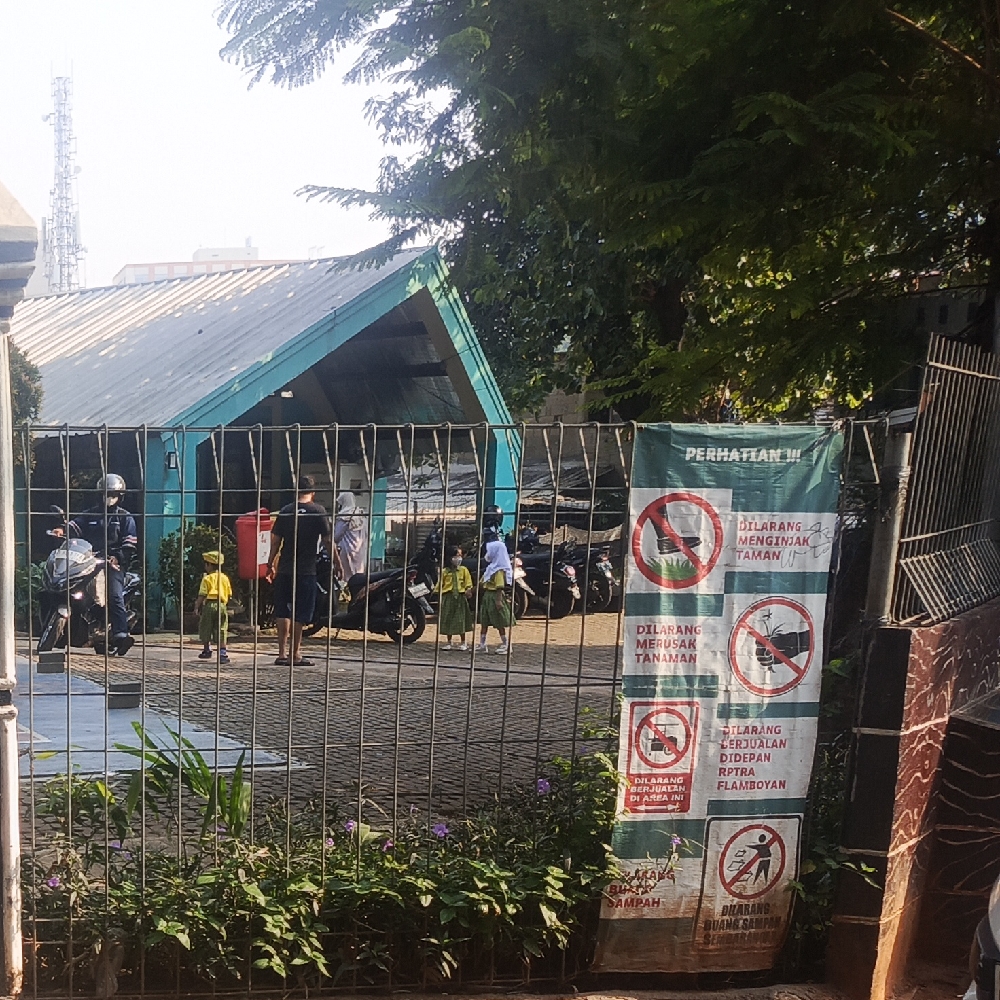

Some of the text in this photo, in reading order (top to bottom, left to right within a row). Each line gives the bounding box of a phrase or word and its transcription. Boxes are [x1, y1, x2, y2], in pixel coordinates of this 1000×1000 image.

[685, 447, 801, 463] PERHATIAN !!!
[739, 521, 802, 532] DILARANG
[738, 535, 810, 547] MENGINJAK
[736, 550, 781, 561] TAMAN
[636, 624, 702, 636] DILARANG
[636, 638, 697, 650] MERUSAK
[635, 653, 698, 665] TANAMAN
[723, 725, 782, 736] DILARANG
[720, 739, 787, 750] BERJUALAN
[719, 752, 771, 763] DIDEPAN
[718, 767, 756, 777] RPTRA
[634, 776, 684, 785] DILARANG
[717, 779, 787, 791] FLAMBOYAN
[630, 785, 686, 793] BERJUALAN
[643, 794, 669, 802] AREA
[607, 898, 661, 909] SAMPAH
[721, 903, 771, 916] DILARANG
[703, 918, 740, 931] BUANG
